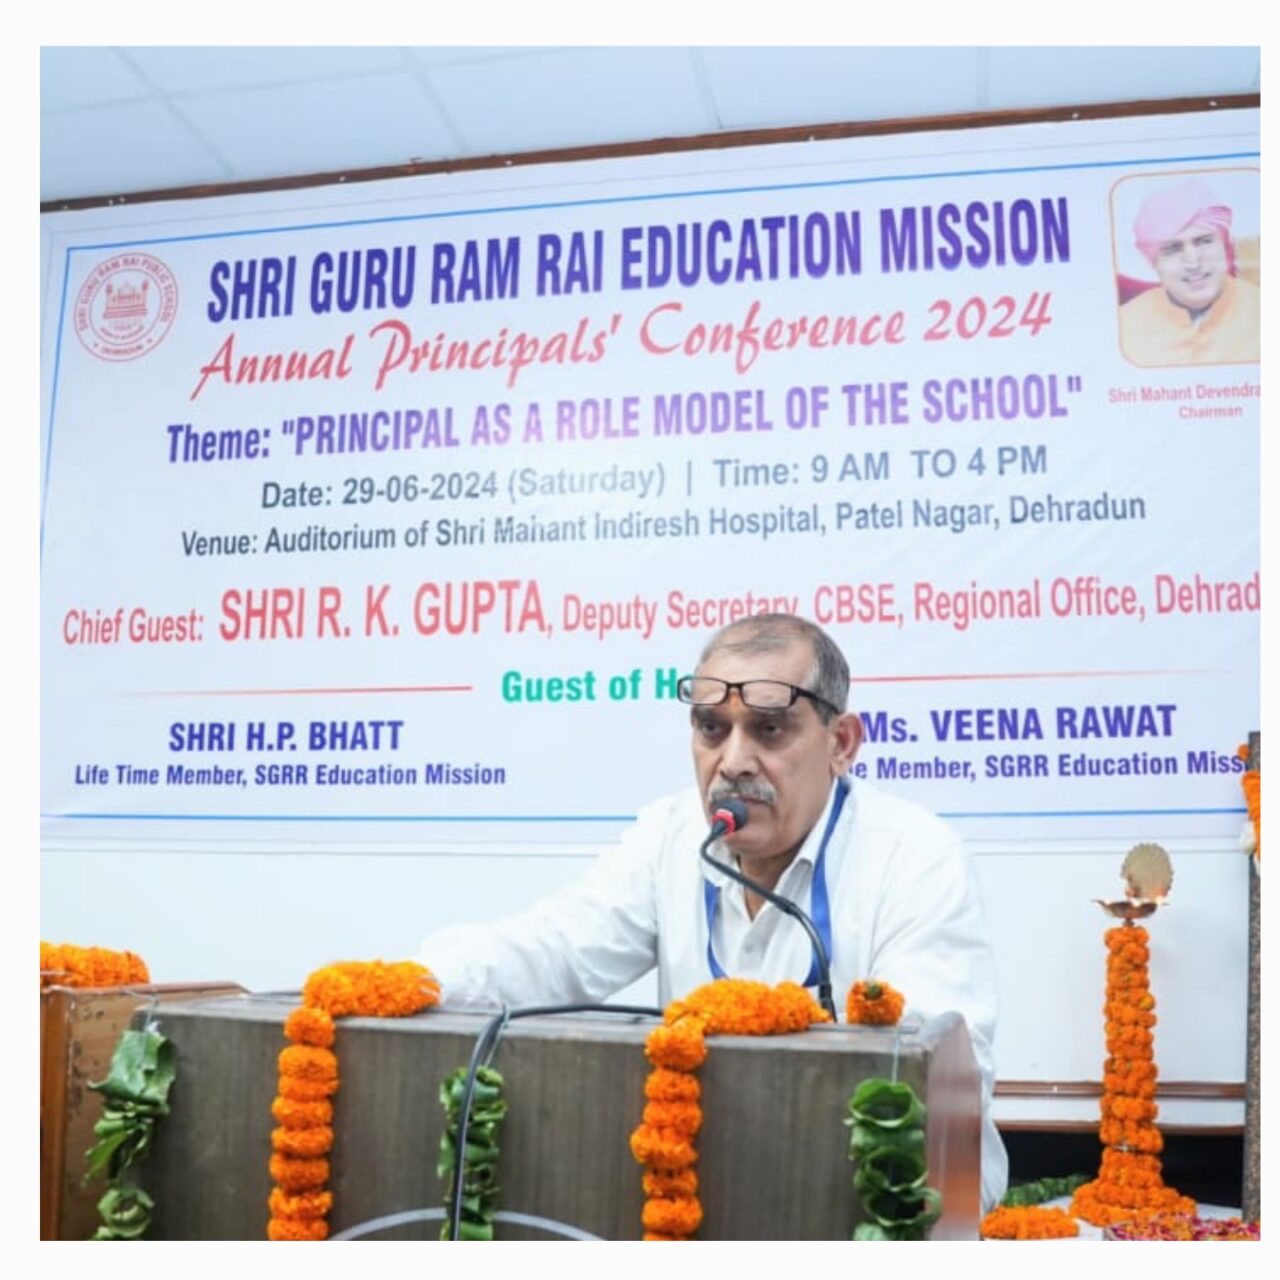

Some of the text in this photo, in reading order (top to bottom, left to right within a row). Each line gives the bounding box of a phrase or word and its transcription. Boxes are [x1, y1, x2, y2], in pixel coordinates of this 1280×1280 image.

[208, 256, 296, 323] SHRI
[310, 246, 416, 314] GURU
[431, 237, 520, 304] RAM
[537, 230, 603, 296] RAI
[621, 211, 861, 289] EDUCATION
[880, 197, 1069, 272] MISSION
[190, 292, 1052, 400] Annual Principals' Conference 2024
[1108, 388, 1137, 403] Shri
[1141, 386, 1192, 402] Mahant
[167, 374, 1081, 462] Theme: "PRINCIPAL AS A ROLE MODEL OF THE SCHOOL"
[1179, 406, 1243, 419] Chairman
[262, 445, 1046, 508] Date: 29-06-2024 (Saturday) Time: 9 AM TO 4 PM
[502, 669, 641, 702] Guest of
[169, 721, 403, 751] SHRI H.P. BHATT
[930, 705, 1176, 741] VEENA RAWAT
[75, 764, 505, 786] Life Time Member, SGRR Education Mission
